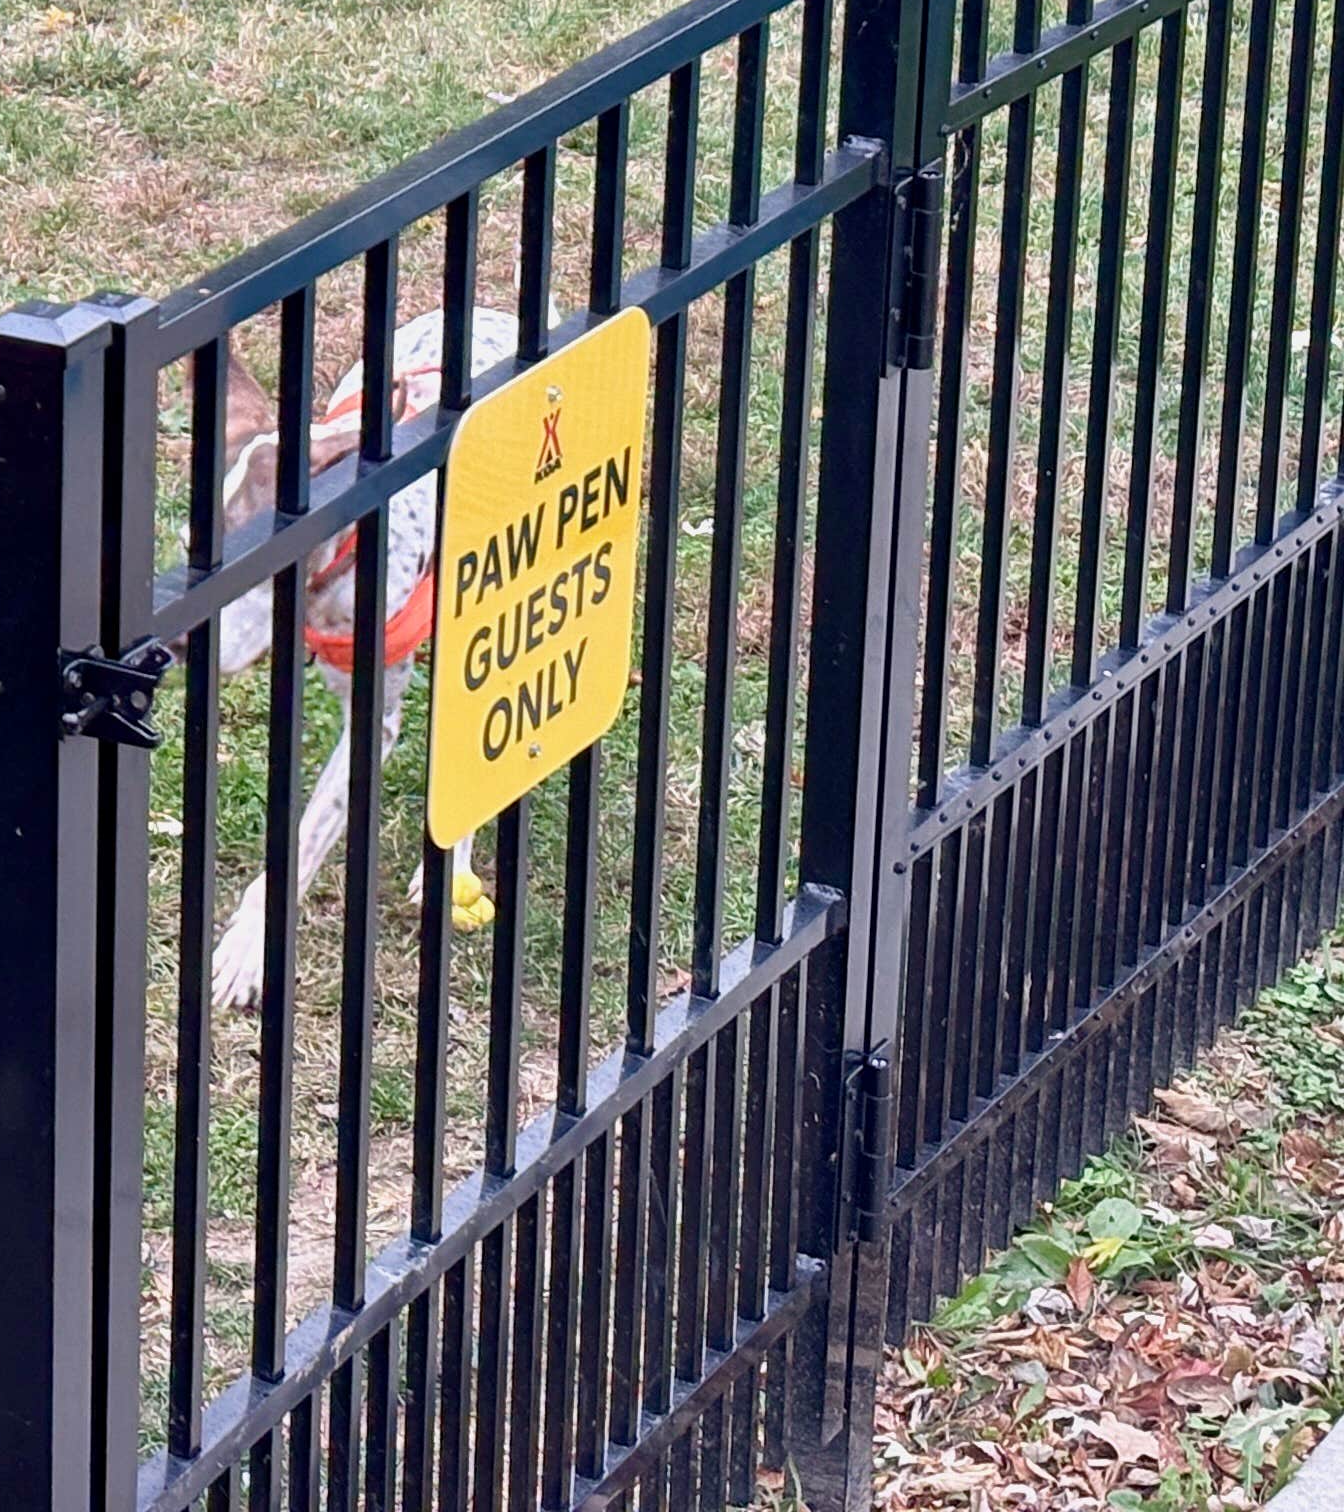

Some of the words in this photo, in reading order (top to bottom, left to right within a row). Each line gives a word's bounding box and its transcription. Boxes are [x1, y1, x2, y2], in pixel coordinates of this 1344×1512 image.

[454, 501, 546, 618] PAW
[556, 445, 631, 550] PEN
[464, 541, 613, 692] GUESTS
[482, 636, 588, 762] ONLY
